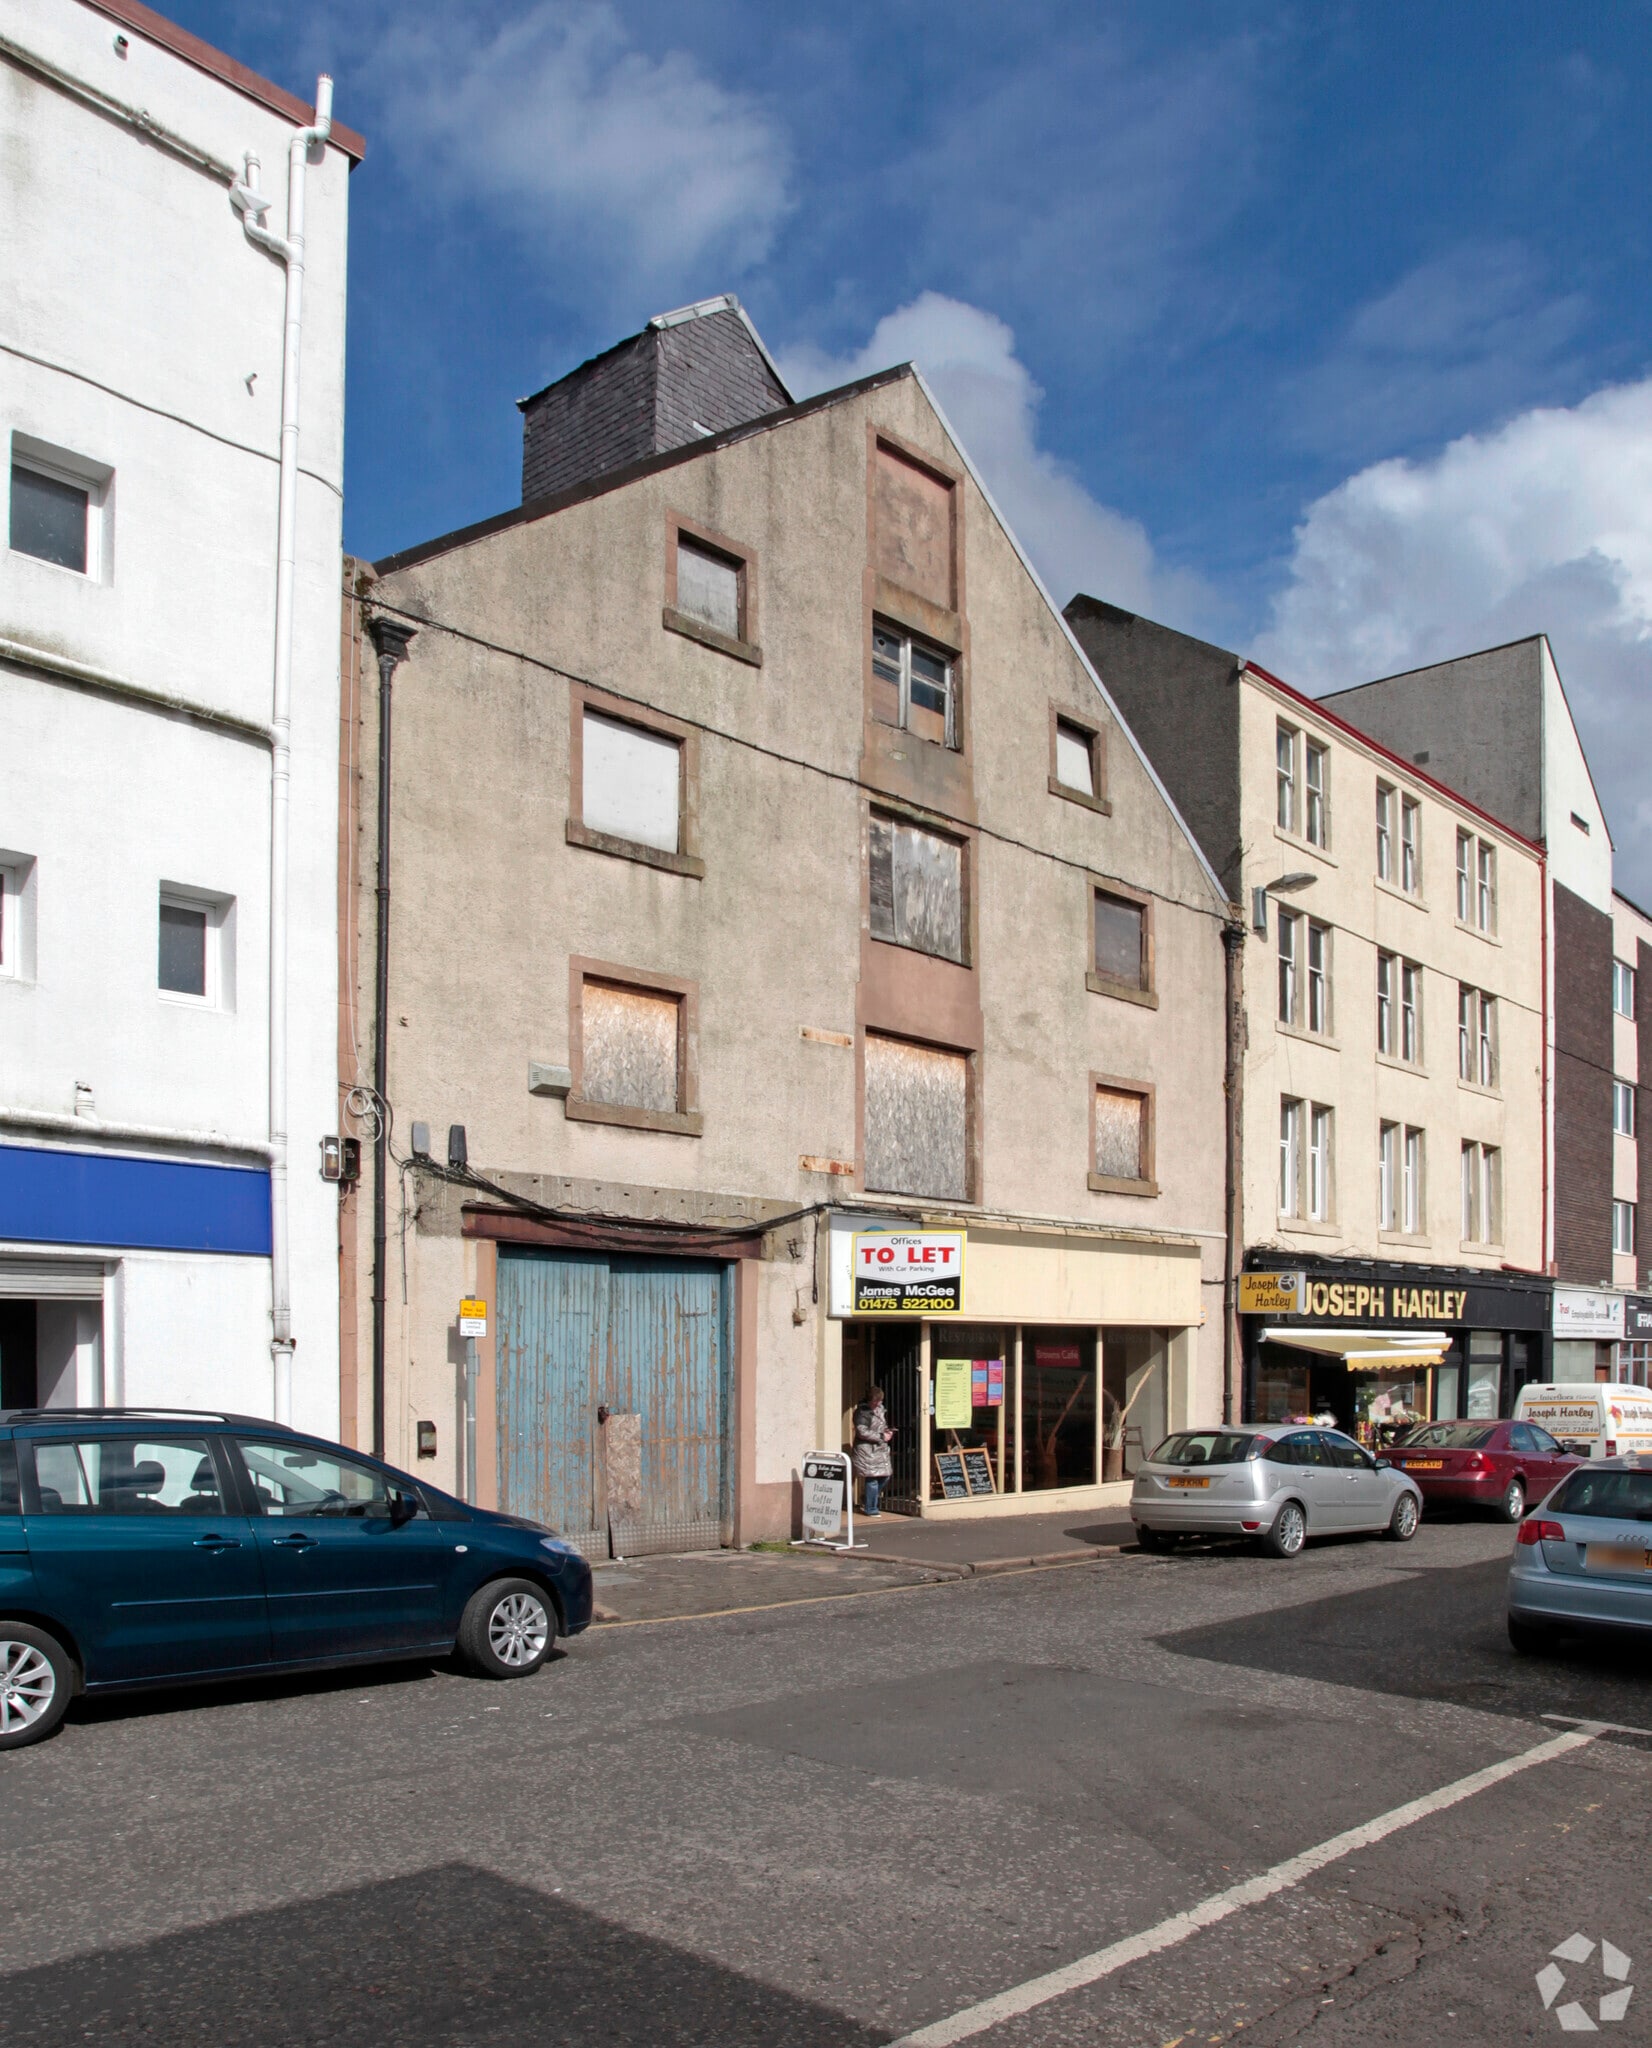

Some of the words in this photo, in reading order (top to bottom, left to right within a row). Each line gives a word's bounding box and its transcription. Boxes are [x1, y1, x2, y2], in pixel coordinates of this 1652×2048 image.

[890, 1237, 922, 1245] Offices
[861, 1247, 895, 1264] TO
[907, 1247, 955, 1263] LET
[909, 1265, 935, 1273] Parking
[1245, 1276, 1279, 1293] Joseph
[859, 1286, 901, 1296] James
[905, 1285, 955, 1296] McGee
[859, 1298, 897, 1309] 01475
[902, 1298, 955, 1309] 522100
[1255, 1293, 1292, 1309] Harley
[1301, 1282, 1385, 1317] JOSEPH
[1392, 1287, 1467, 1319] HARLEY
[1527, 1406, 1557, 1419] Joseph
[1559, 1406, 1594, 1419] Harley
[813, 1483, 833, 1493] Italian
[812, 1494, 833, 1504] Coffee
[806, 1503, 823, 1514] Served
[824, 1505, 839, 1516] Here
[820, 1516, 832, 1527] Day
